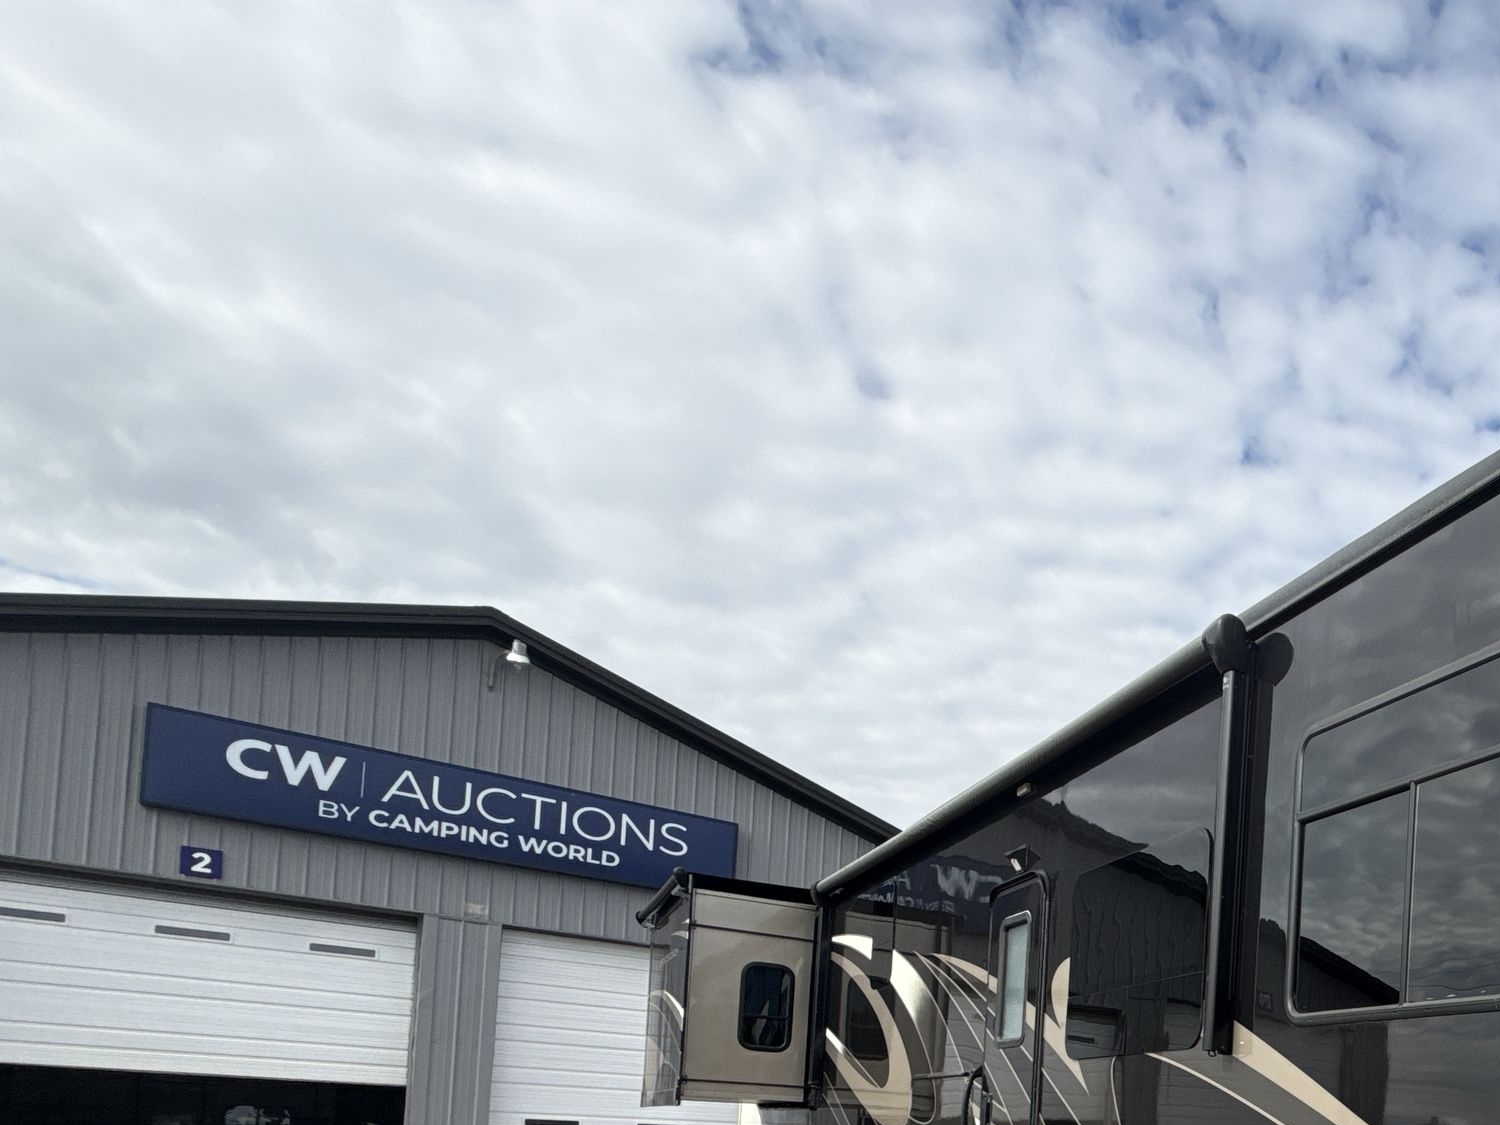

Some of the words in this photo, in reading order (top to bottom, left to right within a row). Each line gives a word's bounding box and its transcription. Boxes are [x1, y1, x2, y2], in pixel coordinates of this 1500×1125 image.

[225, 738, 347, 792] CW
[381, 769, 689, 857] AUCTIONS
[190, 852, 212, 874] 2
[318, 799, 360, 822] BY
[368, 809, 509, 848] CAMPING
[517, 835, 620, 867] WORLD
